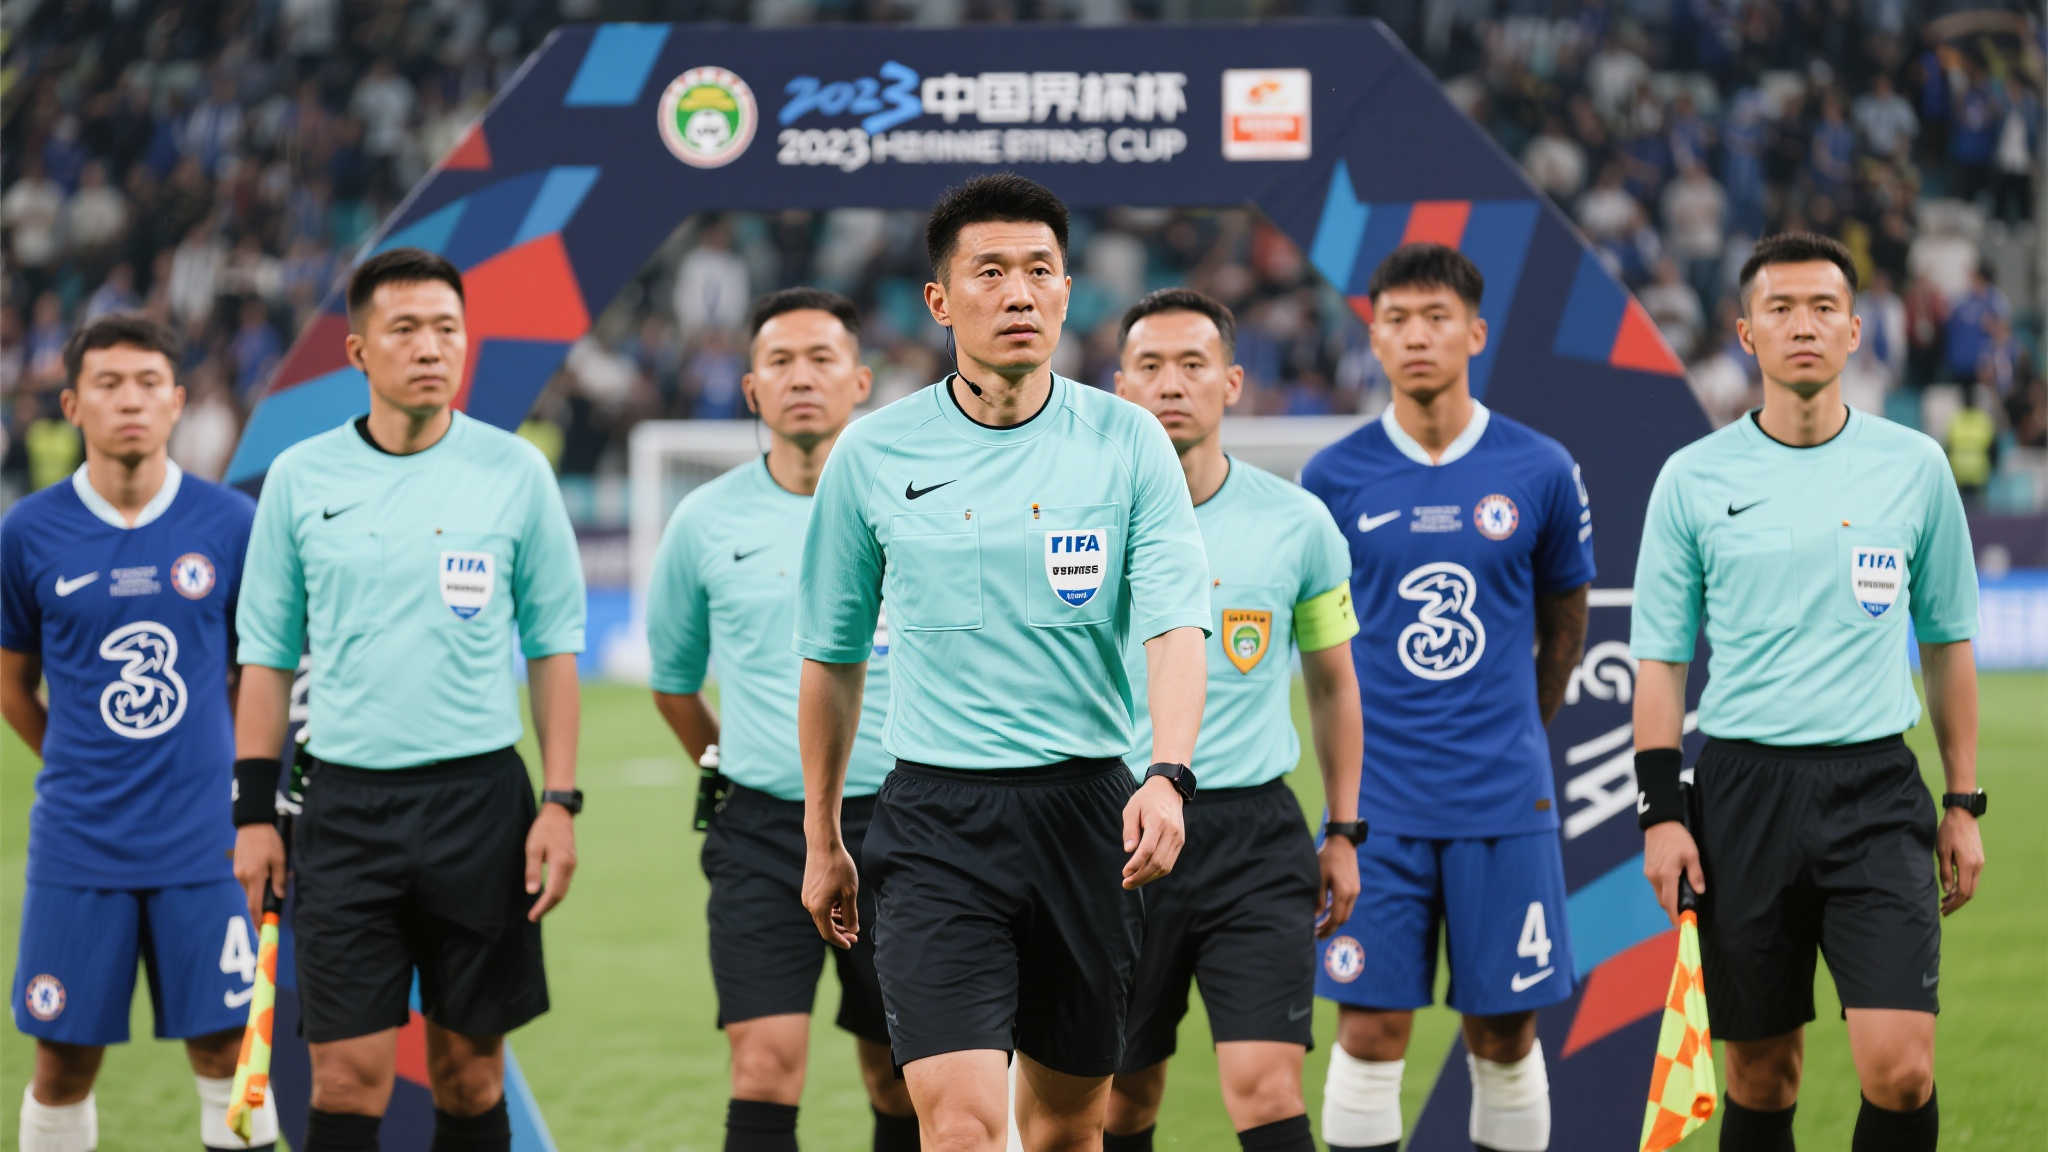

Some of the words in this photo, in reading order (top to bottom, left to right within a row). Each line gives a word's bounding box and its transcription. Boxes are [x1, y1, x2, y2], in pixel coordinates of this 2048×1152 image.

[1108, 127, 1187, 163] CUP
[219, 915, 258, 983] 4
[1516, 901, 1552, 967] 4
